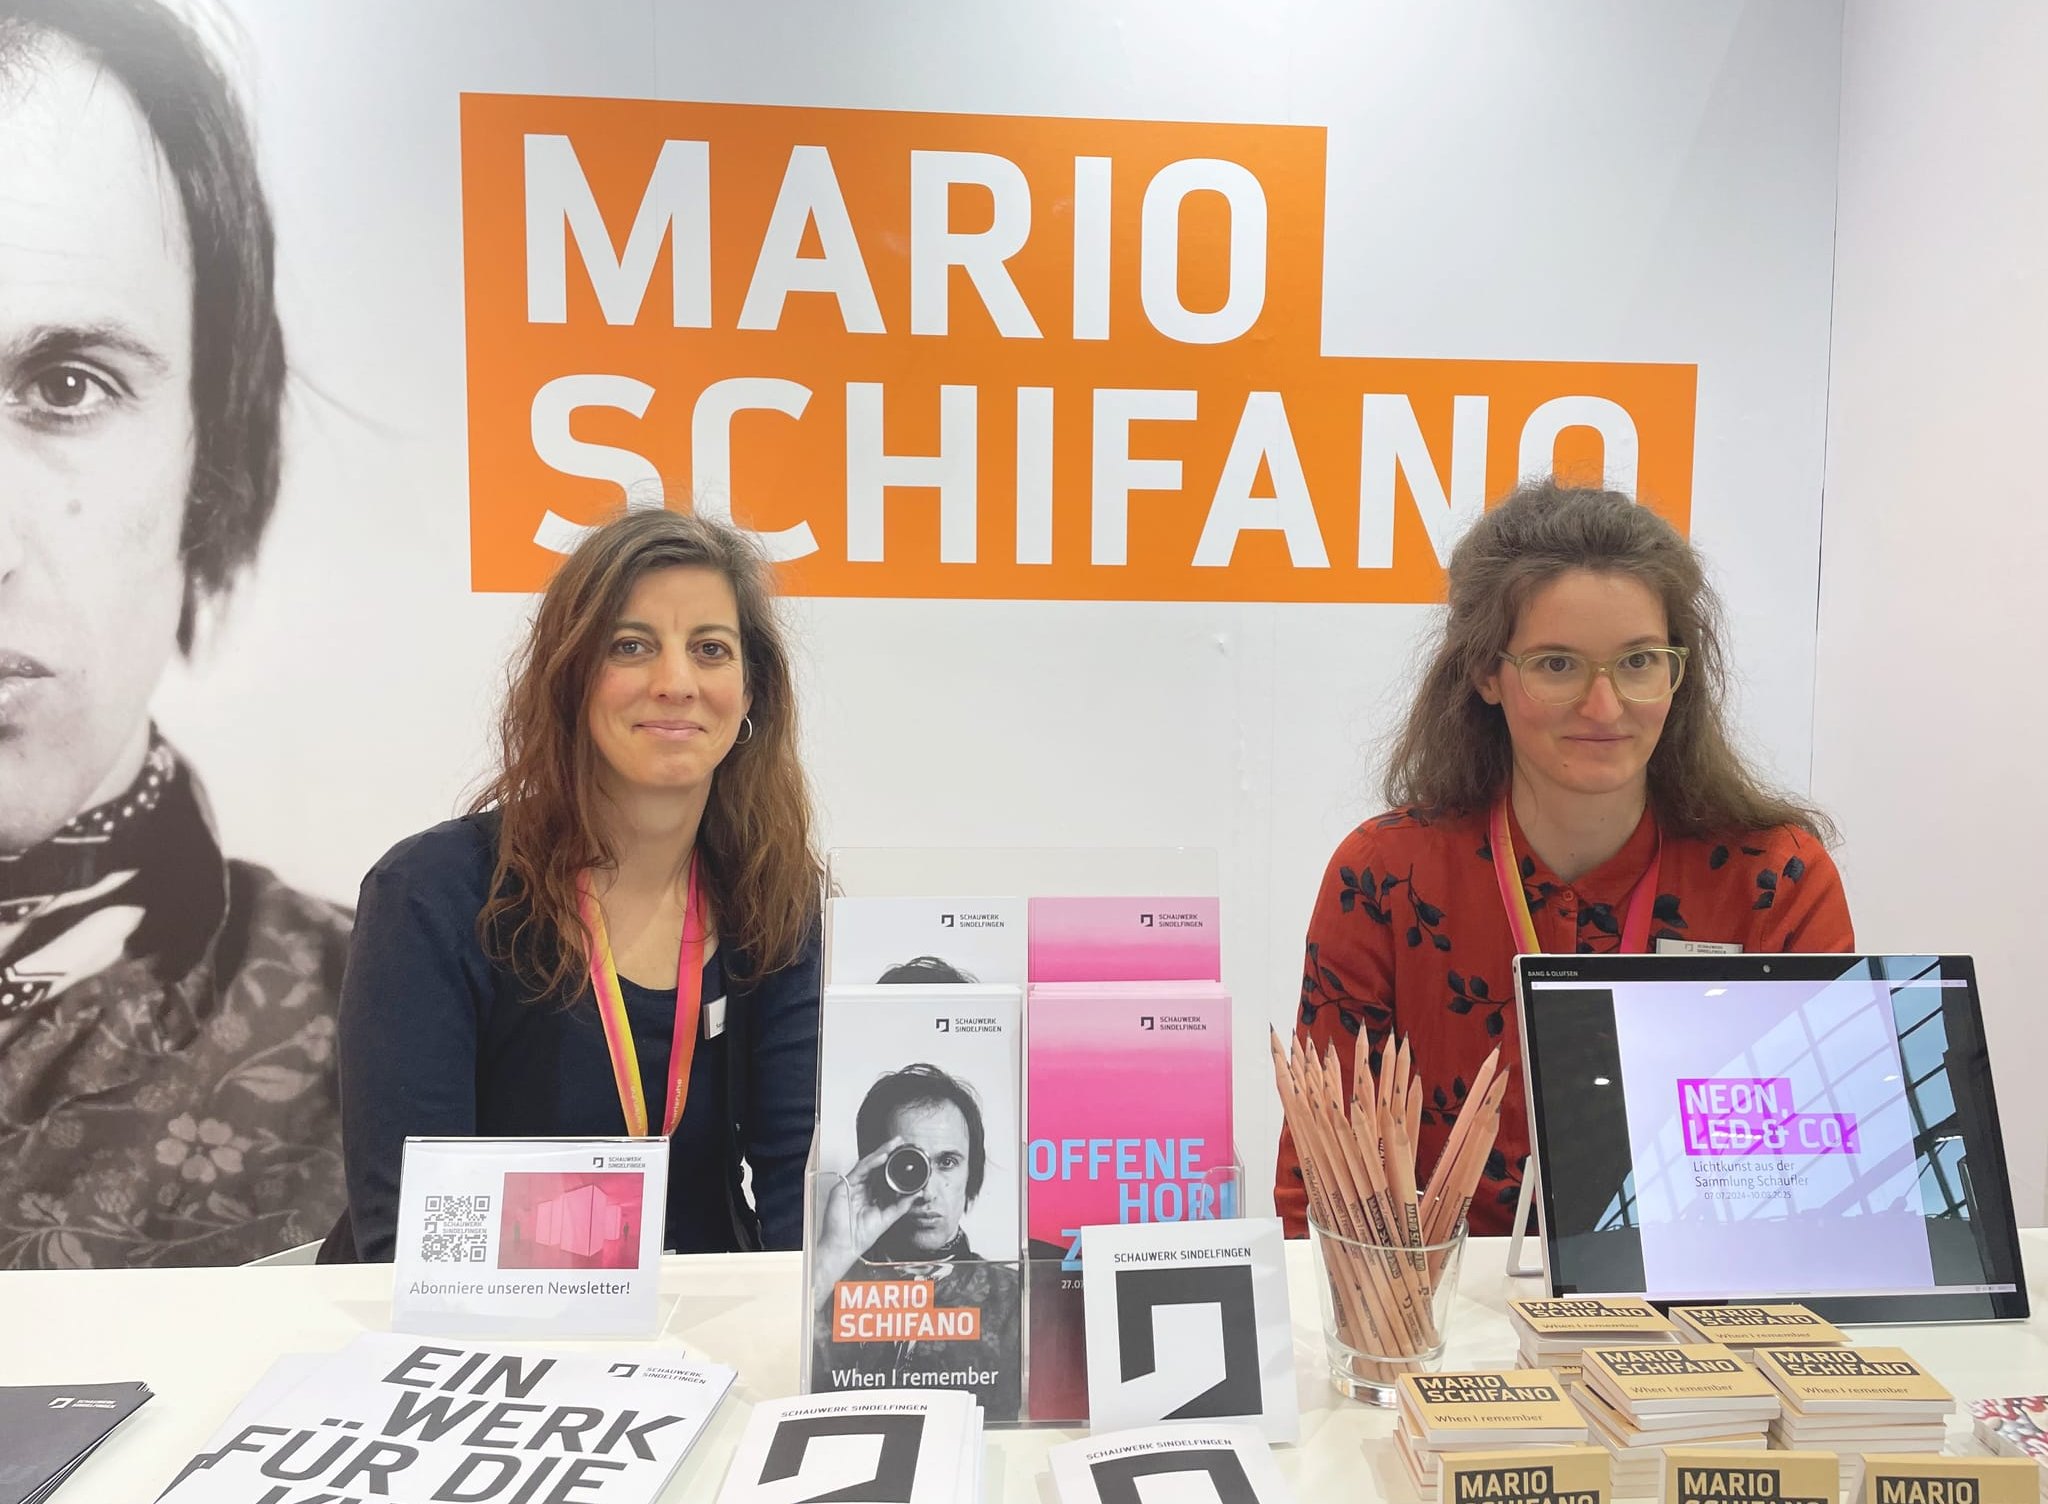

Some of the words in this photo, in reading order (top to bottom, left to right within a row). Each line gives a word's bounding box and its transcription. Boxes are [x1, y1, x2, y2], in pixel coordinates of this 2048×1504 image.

[524, 134, 1268, 344] MARIO
[955, 1017, 997, 1025] SCHAUWERK
[955, 1025, 1002, 1033] SINDELFINGEN
[1684, 1084, 1788, 1118] NEON,
[1687, 1119, 1753, 1150] LED
[1762, 1119, 1789, 1149] &
[1798, 1118, 1854, 1149] CO.
[1028, 1138, 1206, 1181] OFFENE
[1693, 1160, 1751, 1173] Lichtkunst
[1754, 1162, 1774, 1171] aus
[1777, 1160, 1795, 1171] der
[1695, 1175, 1755, 1190] Sammlung
[1114, 1250, 1178, 1263] SCHAUWERK
[1180, 1248, 1251, 1260] SINDELFINGEN
[410, 1281, 483, 1295] Abonniere
[488, 1284, 544, 1295] unseren
[548, 1281, 630, 1295] Newsletter!
[840, 1284, 928, 1309] MARIO
[1526, 1302, 1598, 1310] MARIO
[1533, 1309, 1647, 1318] SCHIFANO
[1691, 1309, 1764, 1318] MARIO
[1700, 1316, 1813, 1325] SCHIFANO
[840, 1312, 974, 1338] SCHIFANO
[1605, 1351, 1688, 1363] MARIO
[1776, 1351, 1858, 1363] MARIO
[381, 1345, 558, 1399] EIN
[1618, 1361, 1736, 1375] SCHIFANO
[1785, 1362, 1913, 1376] SCHIFANO
[642, 1372, 707, 1384] SINDELFINGEN
[832, 1368, 886, 1387] When
[892, 1369, 897, 1386] I
[902, 1366, 999, 1386] remember
[1421, 1377, 1501, 1390] MARIO
[1427, 1387, 1552, 1402] SCHIFANO
[1630, 1385, 1664, 1395] When
[1673, 1384, 1733, 1392] remember
[1802, 1386, 1837, 1395] When
[1846, 1386, 1908, 1394] remember
[781, 1405, 848, 1418] SCHAUWERK
[851, 1404, 928, 1412] SINDELFINGEN
[1435, 1414, 1472, 1423] When
[1479, 1413, 1543, 1422] remember
[381, 1391, 687, 1462] WERK
[1086, 1443, 1153, 1460] SCHAUWERK
[1156, 1438, 1233, 1449] SINDELFINGEN
[198, 1418, 420, 1496] FÜR
[430, 1452, 628, 1504] DIE
[1461, 1470, 1548, 1499] MARIO
[1684, 1471, 1774, 1497] MARIO
[1882, 1479, 1973, 1504] MARIO
